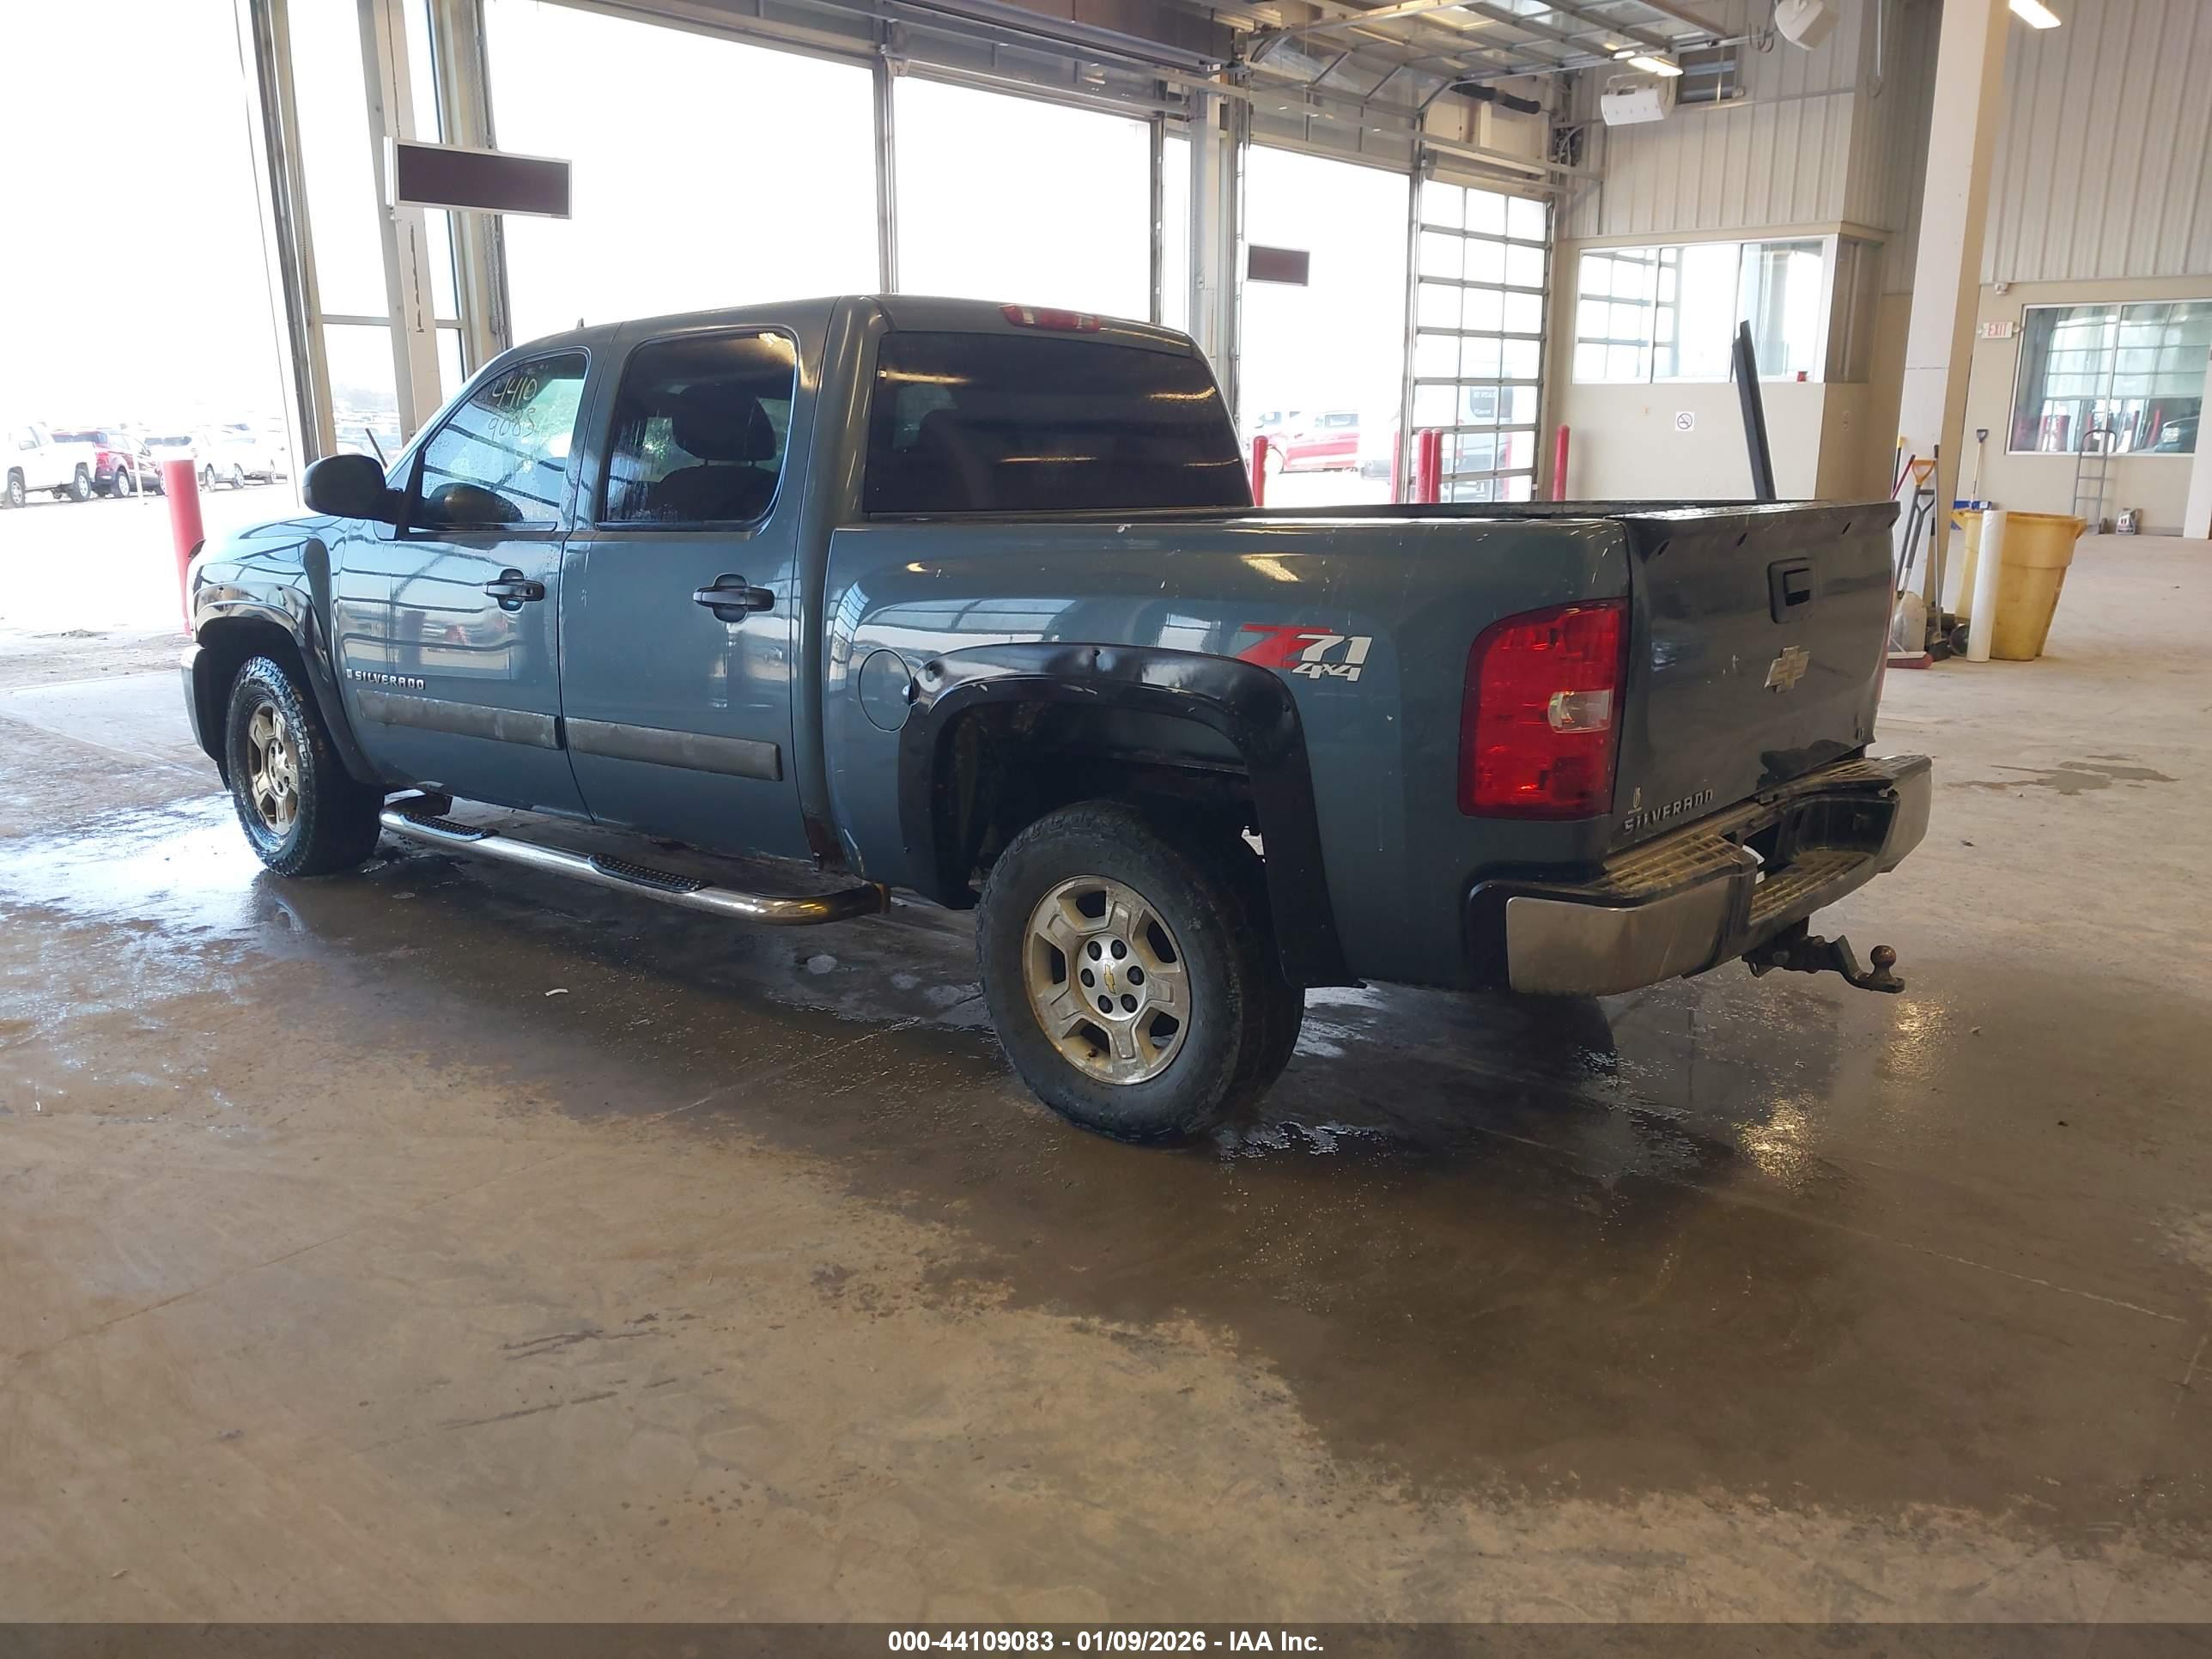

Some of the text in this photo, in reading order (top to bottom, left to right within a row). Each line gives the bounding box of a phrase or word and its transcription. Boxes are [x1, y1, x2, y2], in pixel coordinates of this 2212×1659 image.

[1988, 322, 2008, 337] EXIT
[492, 376, 538, 408] 4410
[1237, 623, 1373, 668] Z71
[355, 671, 425, 690] SILVERADO
[1624, 789, 1713, 835] SILVERADO
